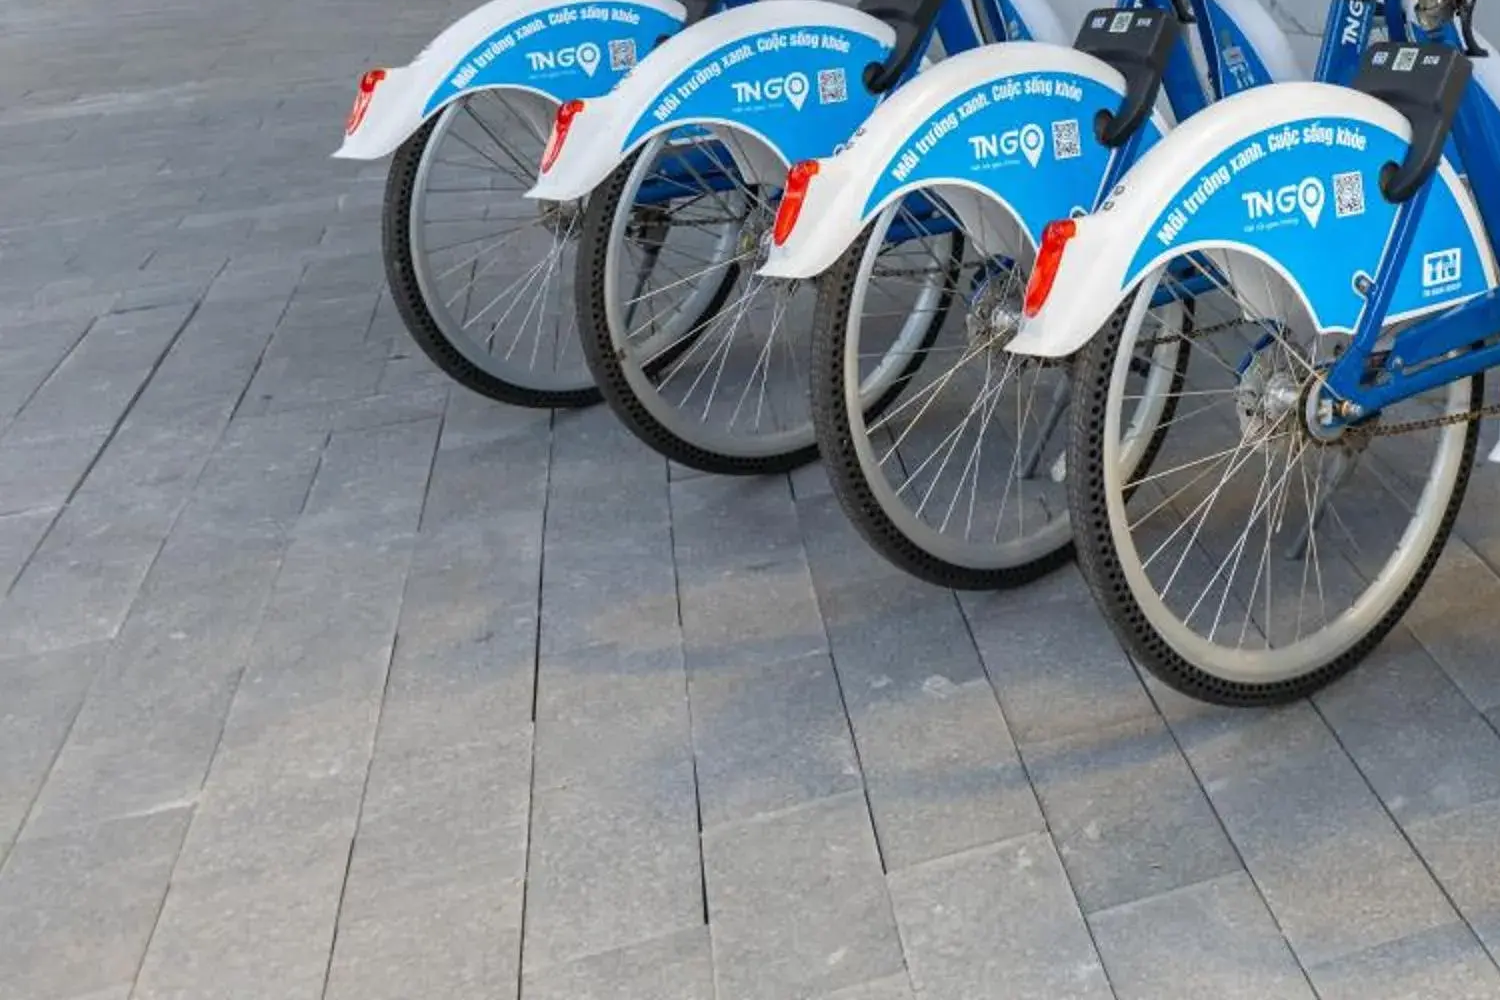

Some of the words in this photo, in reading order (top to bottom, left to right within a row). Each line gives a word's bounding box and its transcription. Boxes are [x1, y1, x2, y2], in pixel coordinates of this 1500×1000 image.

[525, 41, 601, 78] TNGO
[731, 71, 809, 112] TNGO
[891, 151, 920, 182] Môi
[916, 116, 959, 155] trường
[992, 80, 1023, 102] Cuộc
[968, 123, 1045, 169] TNGO
[1156, 211, 1186, 246] Môi
[1183, 166, 1231, 214] trường
[1229, 146, 1267, 175] xanh.
[1267, 125, 1301, 153] Cuộc
[1302, 120, 1334, 149] sống
[1241, 176, 1325, 230] TNGO
